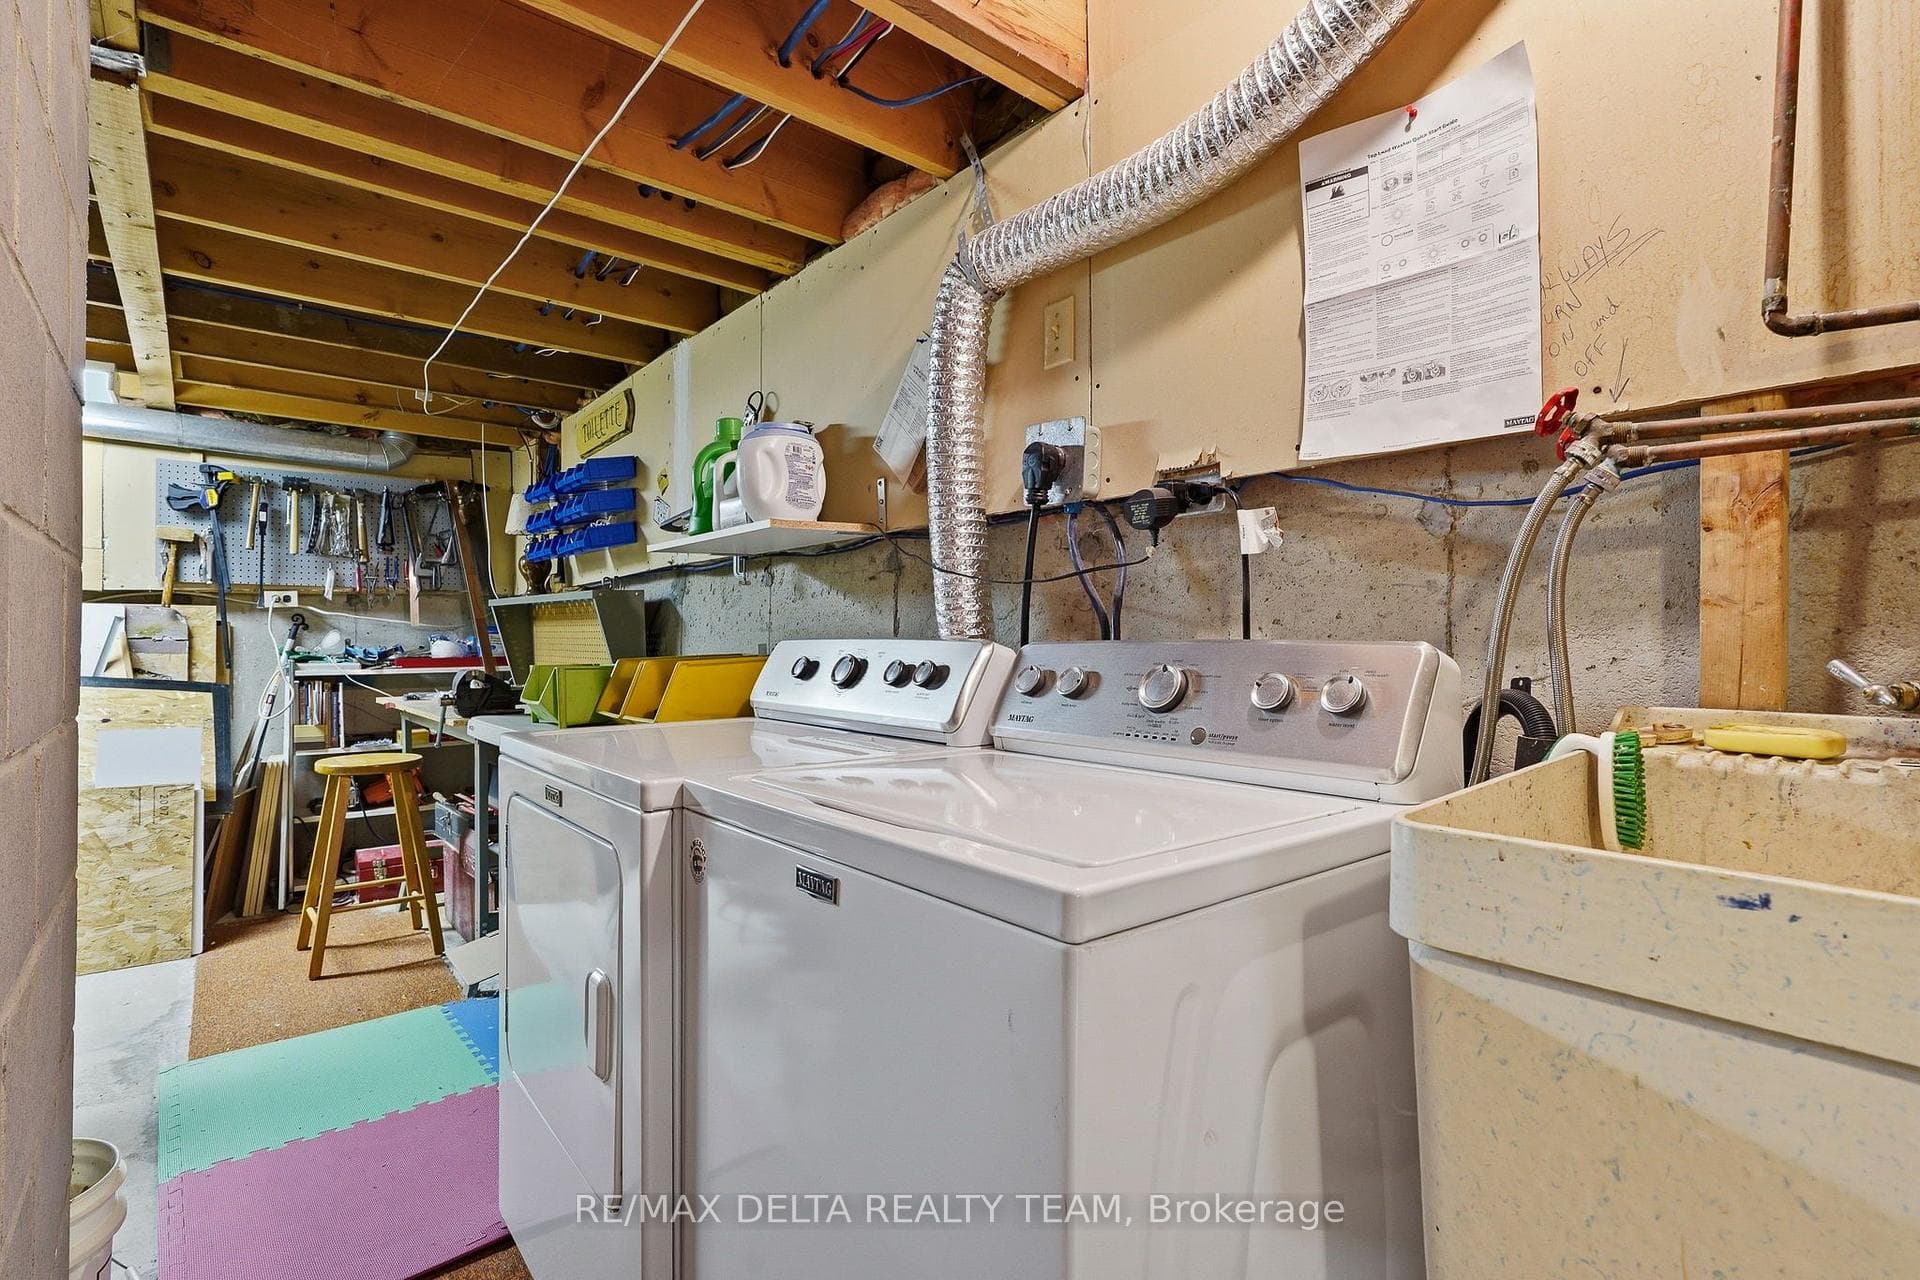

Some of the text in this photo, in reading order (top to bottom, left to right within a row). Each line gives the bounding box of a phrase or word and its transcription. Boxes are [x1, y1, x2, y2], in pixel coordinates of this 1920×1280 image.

[1549, 296, 1620, 358] ON and
[1574, 333, 1607, 377] OFF
[582, 400, 623, 443] TOILETTE
[1505, 416, 1535, 427] MAYTAG
[1008, 713, 1035, 724] MAYTAG
[797, 870, 833, 897] MAYTAG
